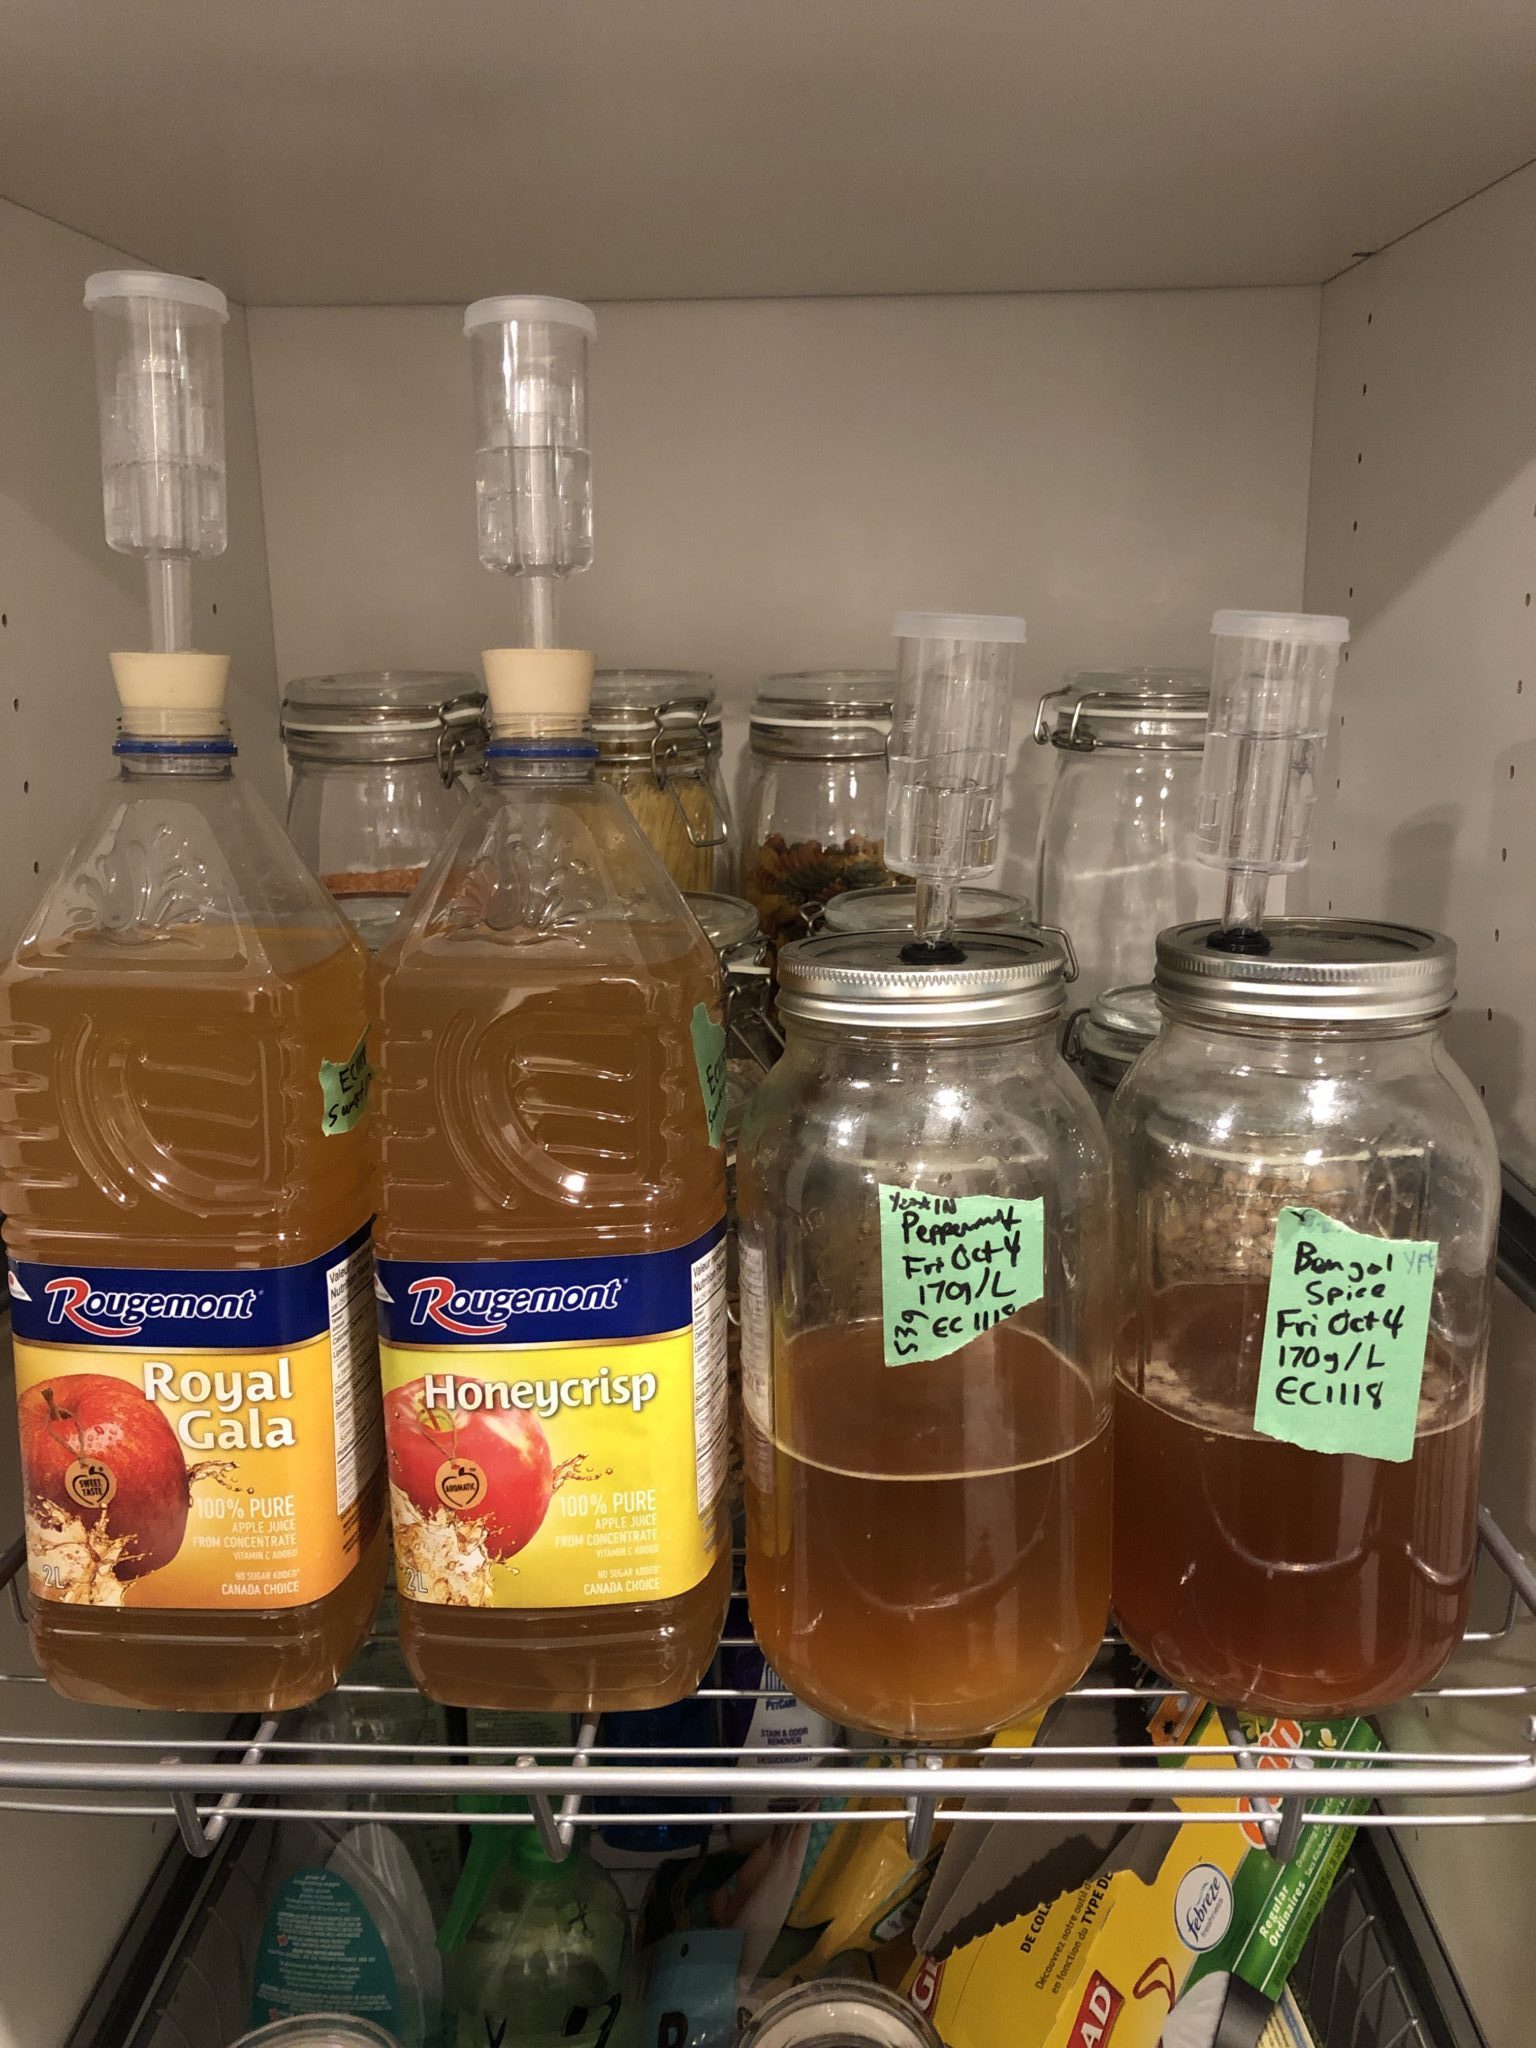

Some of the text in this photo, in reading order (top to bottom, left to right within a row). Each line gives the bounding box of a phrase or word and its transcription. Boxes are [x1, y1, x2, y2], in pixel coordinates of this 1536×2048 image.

[902, 1230, 1021, 1279] Fri Oct 4
[408, 1276, 622, 1336] Rougemont
[1305, 1280, 1386, 1306] Spice
[45, 1277, 256, 1337] Rougemont
[1276, 1305, 1405, 1339] Fri Oct 4
[142, 1357, 294, 1413] Royal
[424, 1367, 657, 1418] Honeycrisp
[178, 1410, 296, 1451] Gala
[196, 1495, 295, 1519] 100% PURE
[560, 1488, 657, 1517] 100% PURE
[232, 1518, 296, 1533] APPLE JUICE
[595, 1513, 656, 1529] APPLE JUICE
[192, 1533, 296, 1547] FROM CONCENTRATE
[555, 1528, 659, 1548] FROM CONCENTRATE
[233, 1551, 264, 1560] VITAMIN
[272, 1548, 298, 1559] ADDED
[595, 1548, 625, 1558] VITAMIN
[42, 1563, 67, 1590] 2L
[221, 1580, 299, 1595] CANADA CHOICE
[405, 1567, 429, 1594] 2L
[583, 1578, 660, 1595] CANADA CHOICE
[1062, 1914, 1078, 1944] notre
[1074, 1889, 1088, 1915] outil
[1080, 1889, 1106, 1926] TYPE
[1186, 1876, 1220, 1943] febreze
[1258, 1884, 1290, 1939] Regular
[1268, 1880, 1307, 1948] Ordinaires
[1019, 1933, 1037, 1954] DE
[1077, 1926, 1088, 1940] du
[1056, 1940, 1082, 1982] fonction
[1051, 1981, 1061, 1994] en
